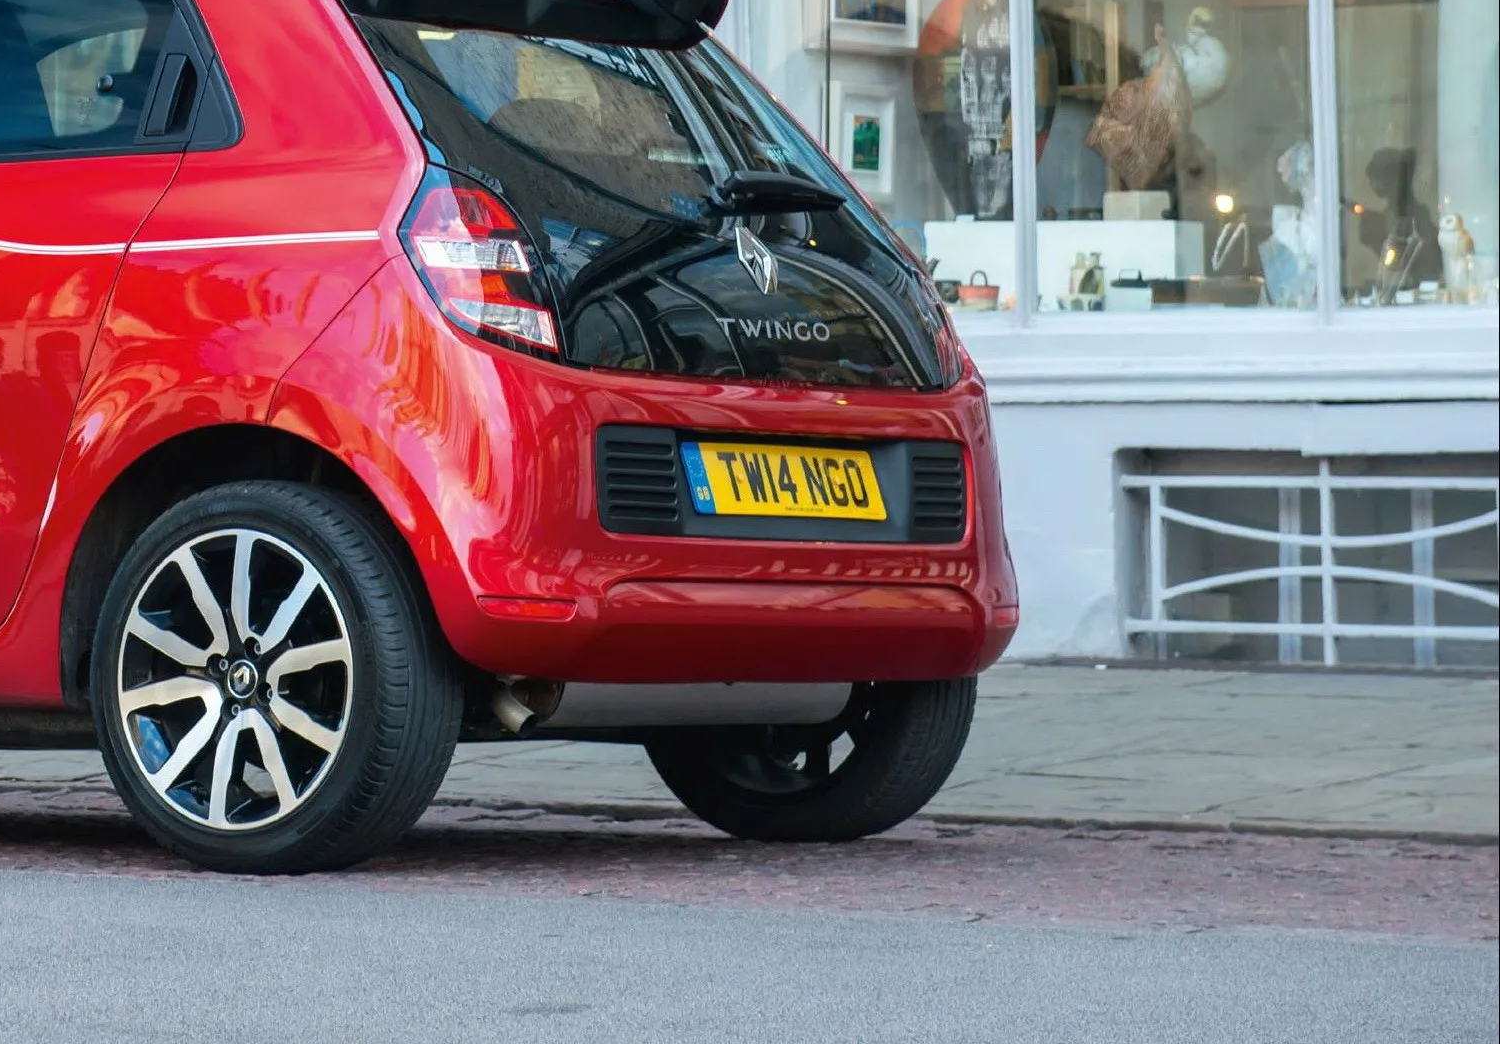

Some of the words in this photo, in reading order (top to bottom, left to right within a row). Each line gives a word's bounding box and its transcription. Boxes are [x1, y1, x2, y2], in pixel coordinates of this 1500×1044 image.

[717, 316, 832, 342] TWINGO
[716, 450, 799, 506] TW14
[801, 456, 870, 509] NGO
